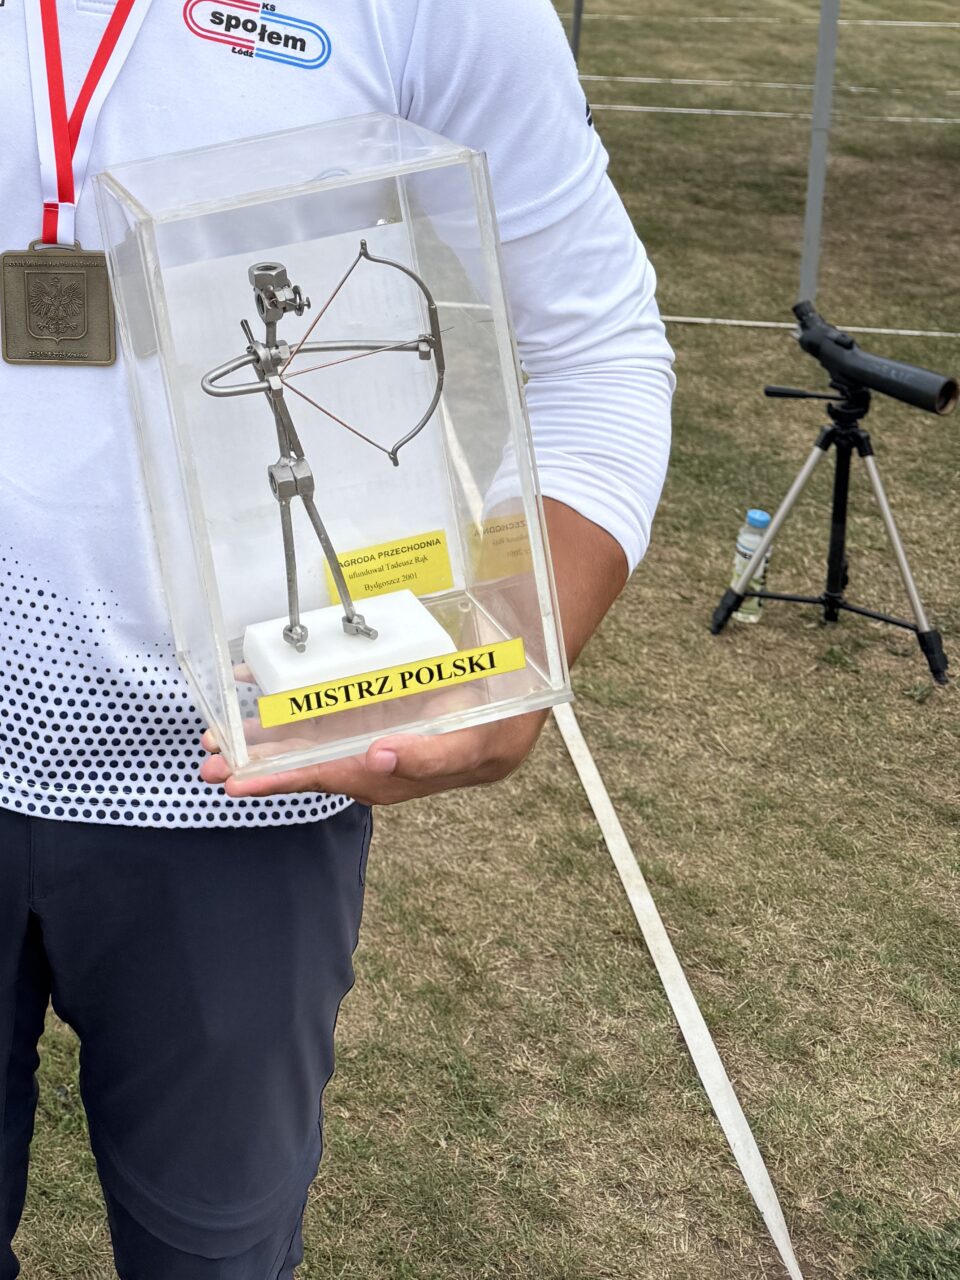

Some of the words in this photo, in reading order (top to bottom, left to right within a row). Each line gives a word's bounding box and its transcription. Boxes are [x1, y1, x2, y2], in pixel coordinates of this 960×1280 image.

[261, 2, 276, 12] KS
[209, 10, 306, 52] społem
[231, 46, 254, 58] Łódź
[339, 554, 376, 569] AGRODA
[378, 538, 442, 560] PRZECHODNIA
[386, 560, 414, 571] Tadeusz
[364, 577, 401, 592] Bydgoszcz
[401, 572, 418, 583] 2001
[288, 675, 394, 716] MISTRZ
[400, 650, 497, 690] POLSKI
